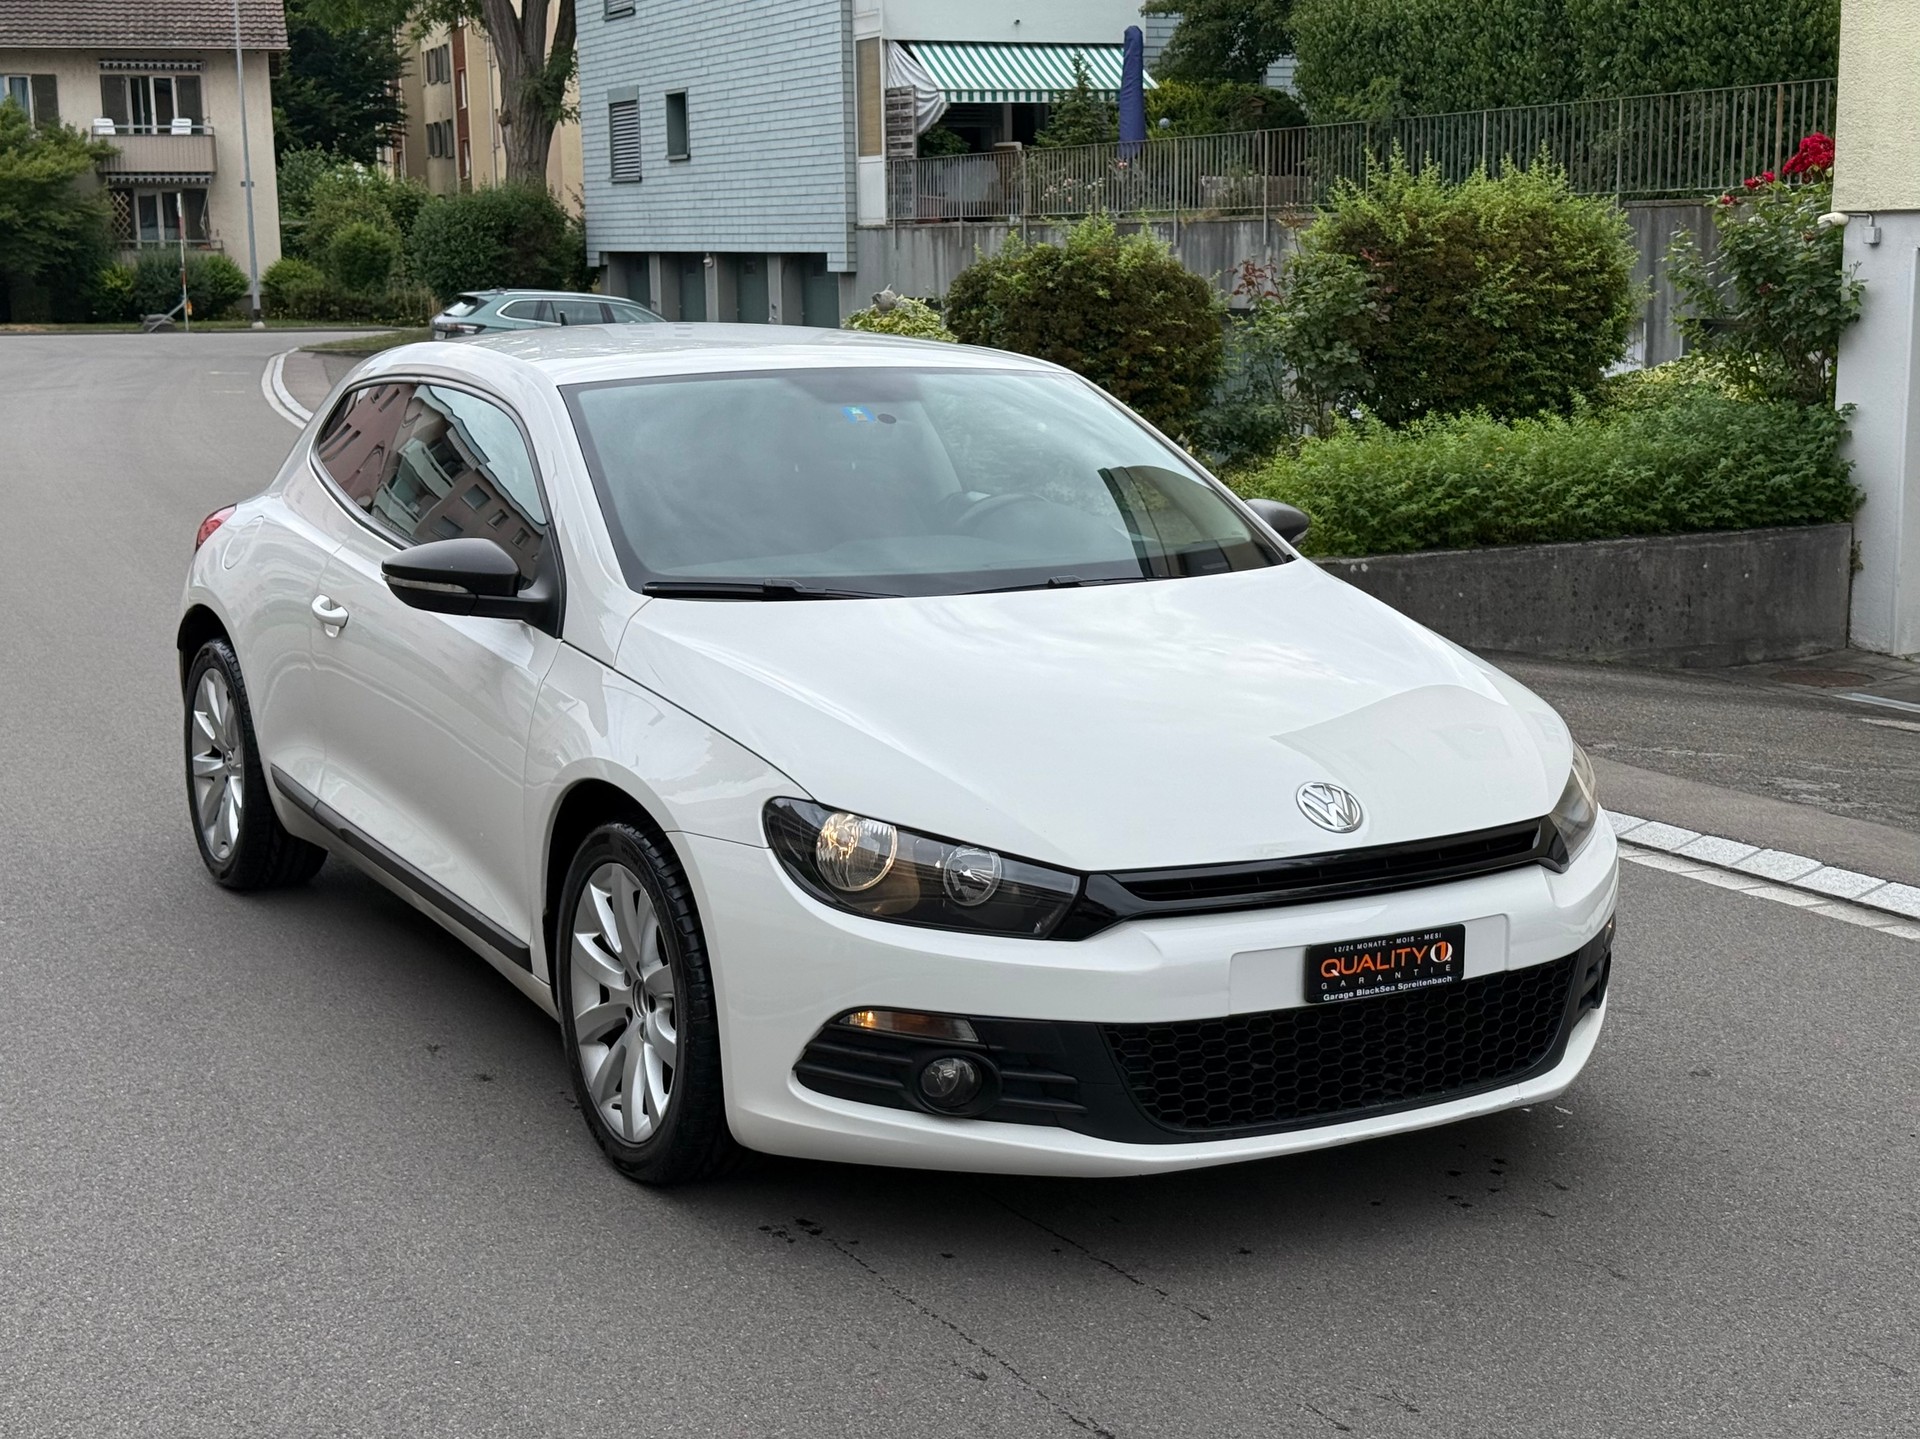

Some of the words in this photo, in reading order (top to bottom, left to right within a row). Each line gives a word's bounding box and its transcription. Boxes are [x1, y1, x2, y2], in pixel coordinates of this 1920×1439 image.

[1334, 945, 1355, 953] 12/24
[1357, 940, 1387, 950] MONATE
[1396, 936, 1415, 944] MOIS
[1424, 932, 1442, 940] MESI
[1321, 945, 1429, 978] QUALITY
[1321, 964, 1452, 990] GARANTIE
[1323, 991, 1354, 1002] Garage
[1356, 984, 1396, 997] BlackSea
[1397, 975, 1453, 991] Spreitenbach
